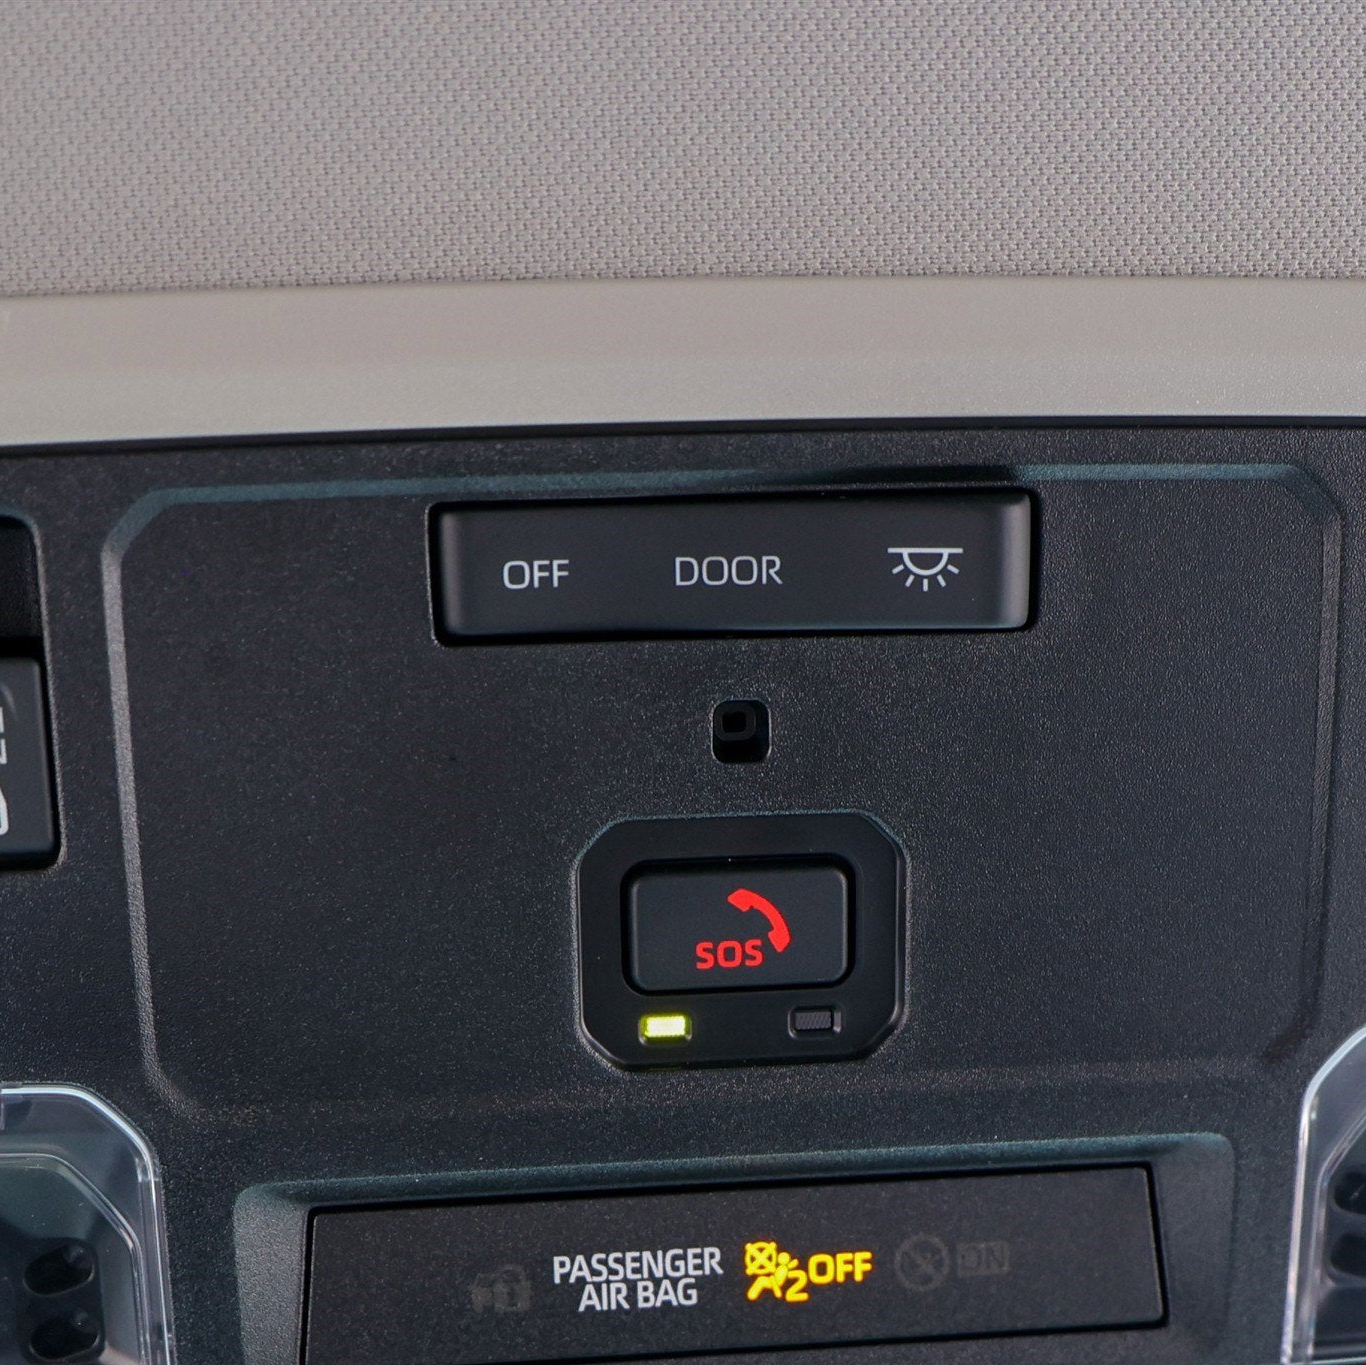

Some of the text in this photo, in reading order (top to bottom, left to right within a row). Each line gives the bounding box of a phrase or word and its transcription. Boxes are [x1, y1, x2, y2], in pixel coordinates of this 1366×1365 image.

[502, 555, 783, 590] OFF DOOR
[695, 939, 763, 970] SOS
[553, 1246, 723, 1285] PASSENGER
[807, 1250, 874, 1286] OFF
[578, 1276, 698, 1312] AIR BAG
